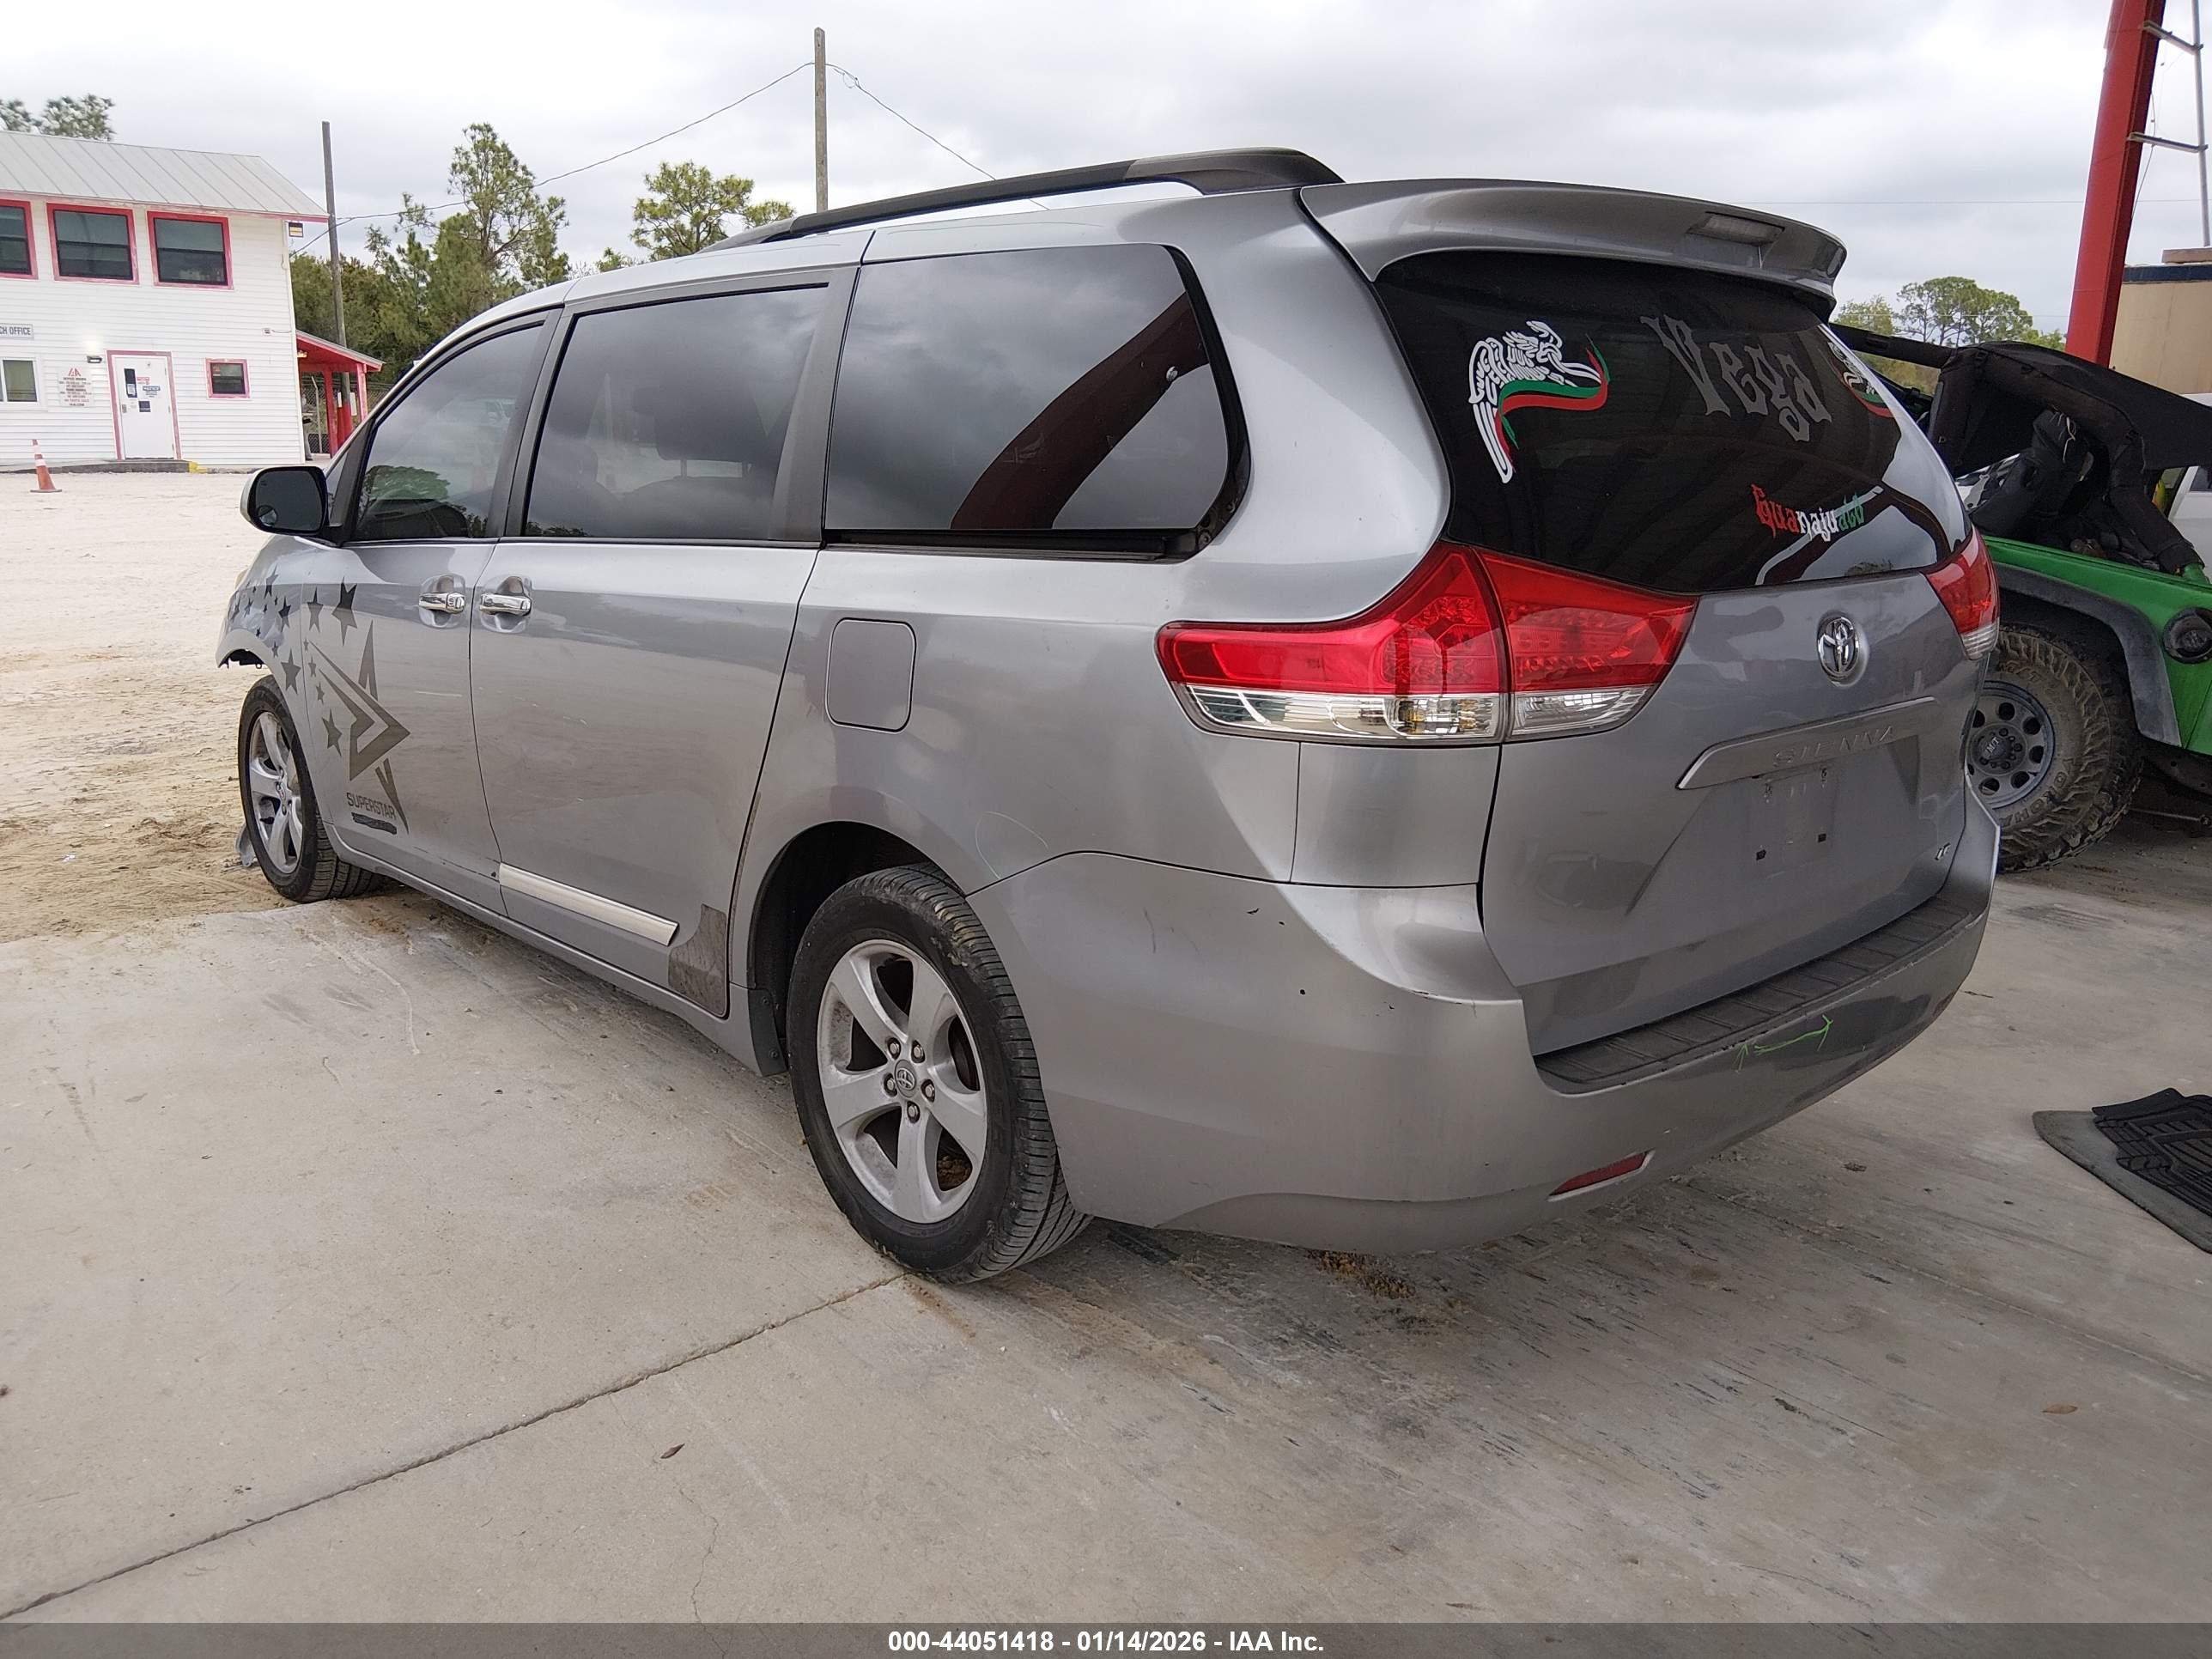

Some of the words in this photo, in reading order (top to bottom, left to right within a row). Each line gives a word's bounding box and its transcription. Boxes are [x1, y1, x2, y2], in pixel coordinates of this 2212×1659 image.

[9, 326, 32, 336] OFFICE
[1638, 314, 1832, 441] Vega
[345, 792, 397, 821] SUPERSTAR
